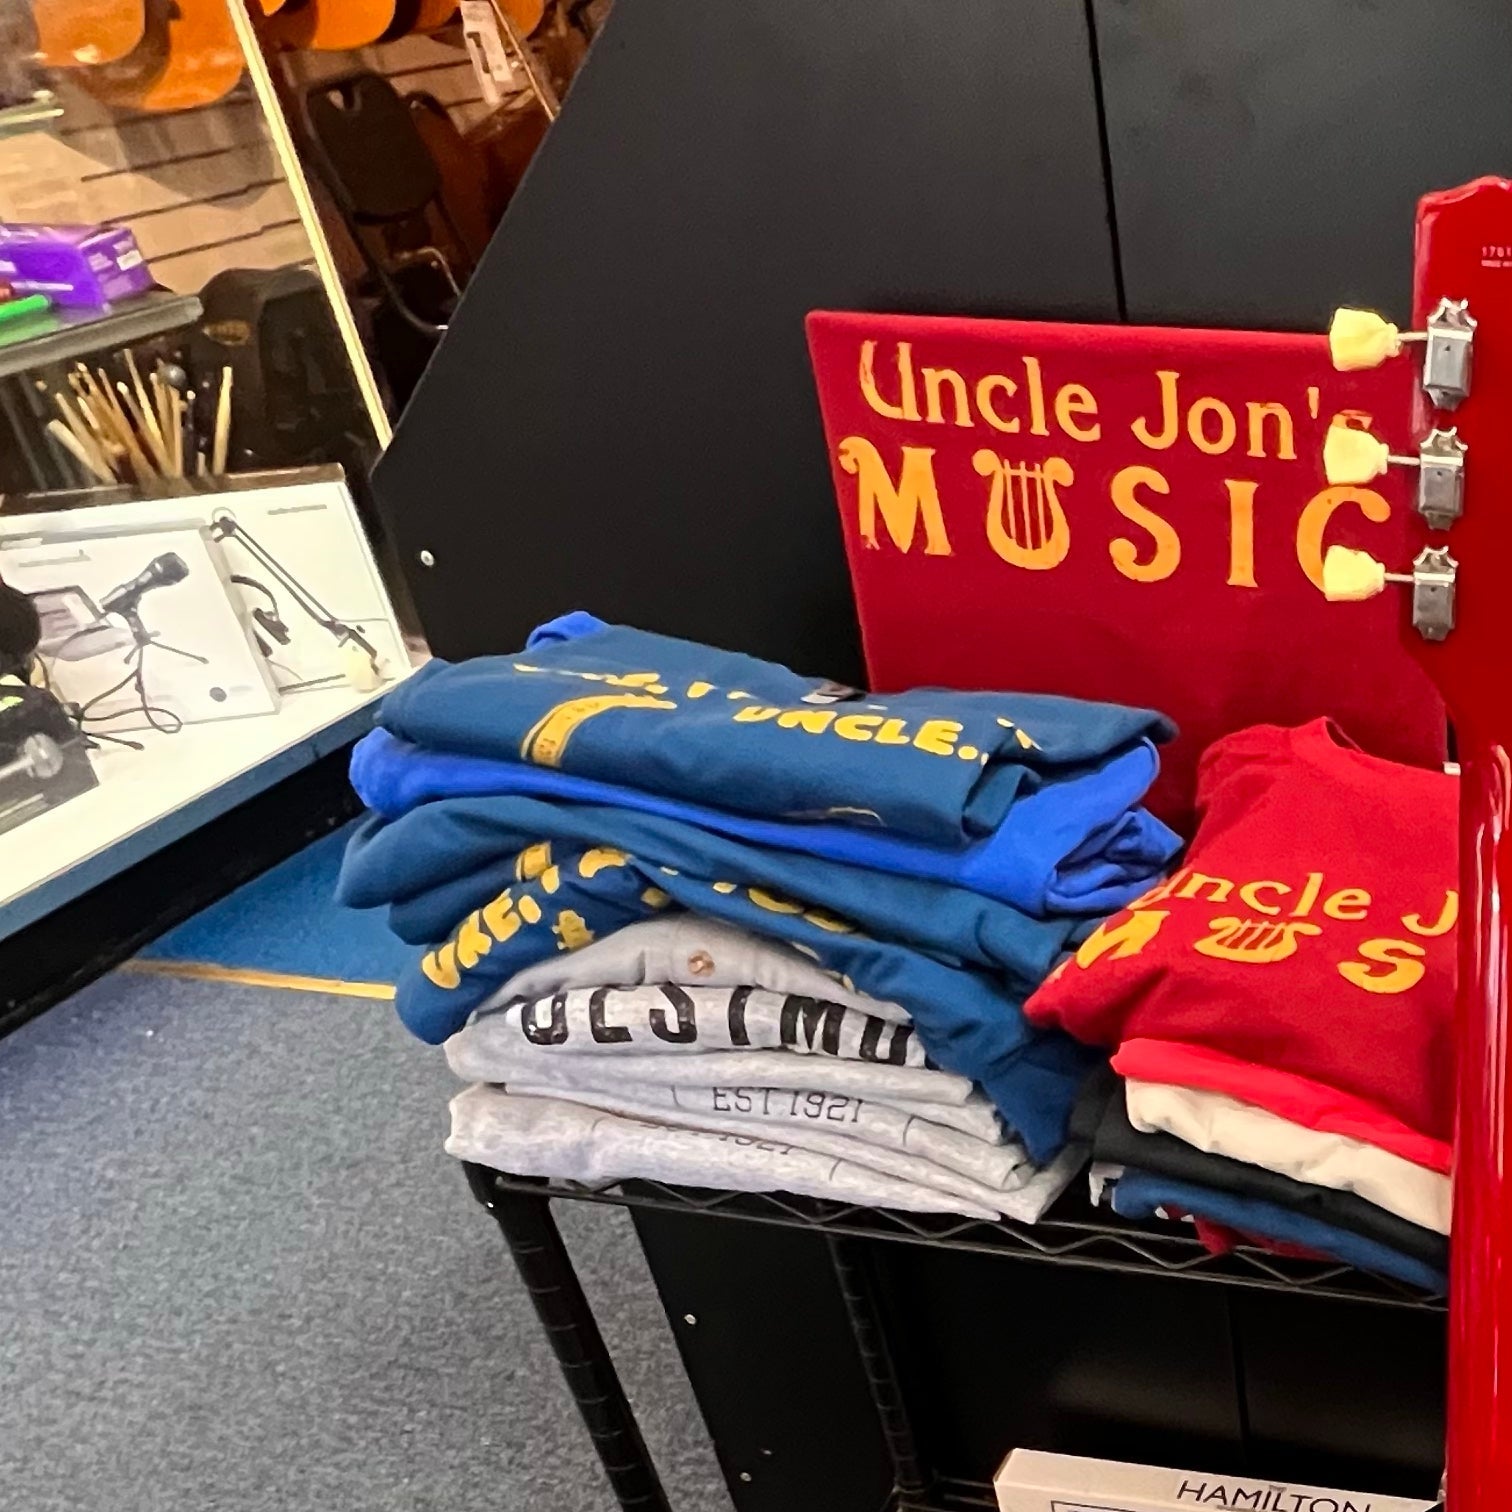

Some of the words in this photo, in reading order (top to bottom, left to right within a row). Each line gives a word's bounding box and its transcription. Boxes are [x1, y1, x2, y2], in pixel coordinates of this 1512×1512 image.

[859, 340, 1101, 442] Uncle
[713, 1086, 779, 1115] EST
[789, 1089, 865, 1123] 1921
